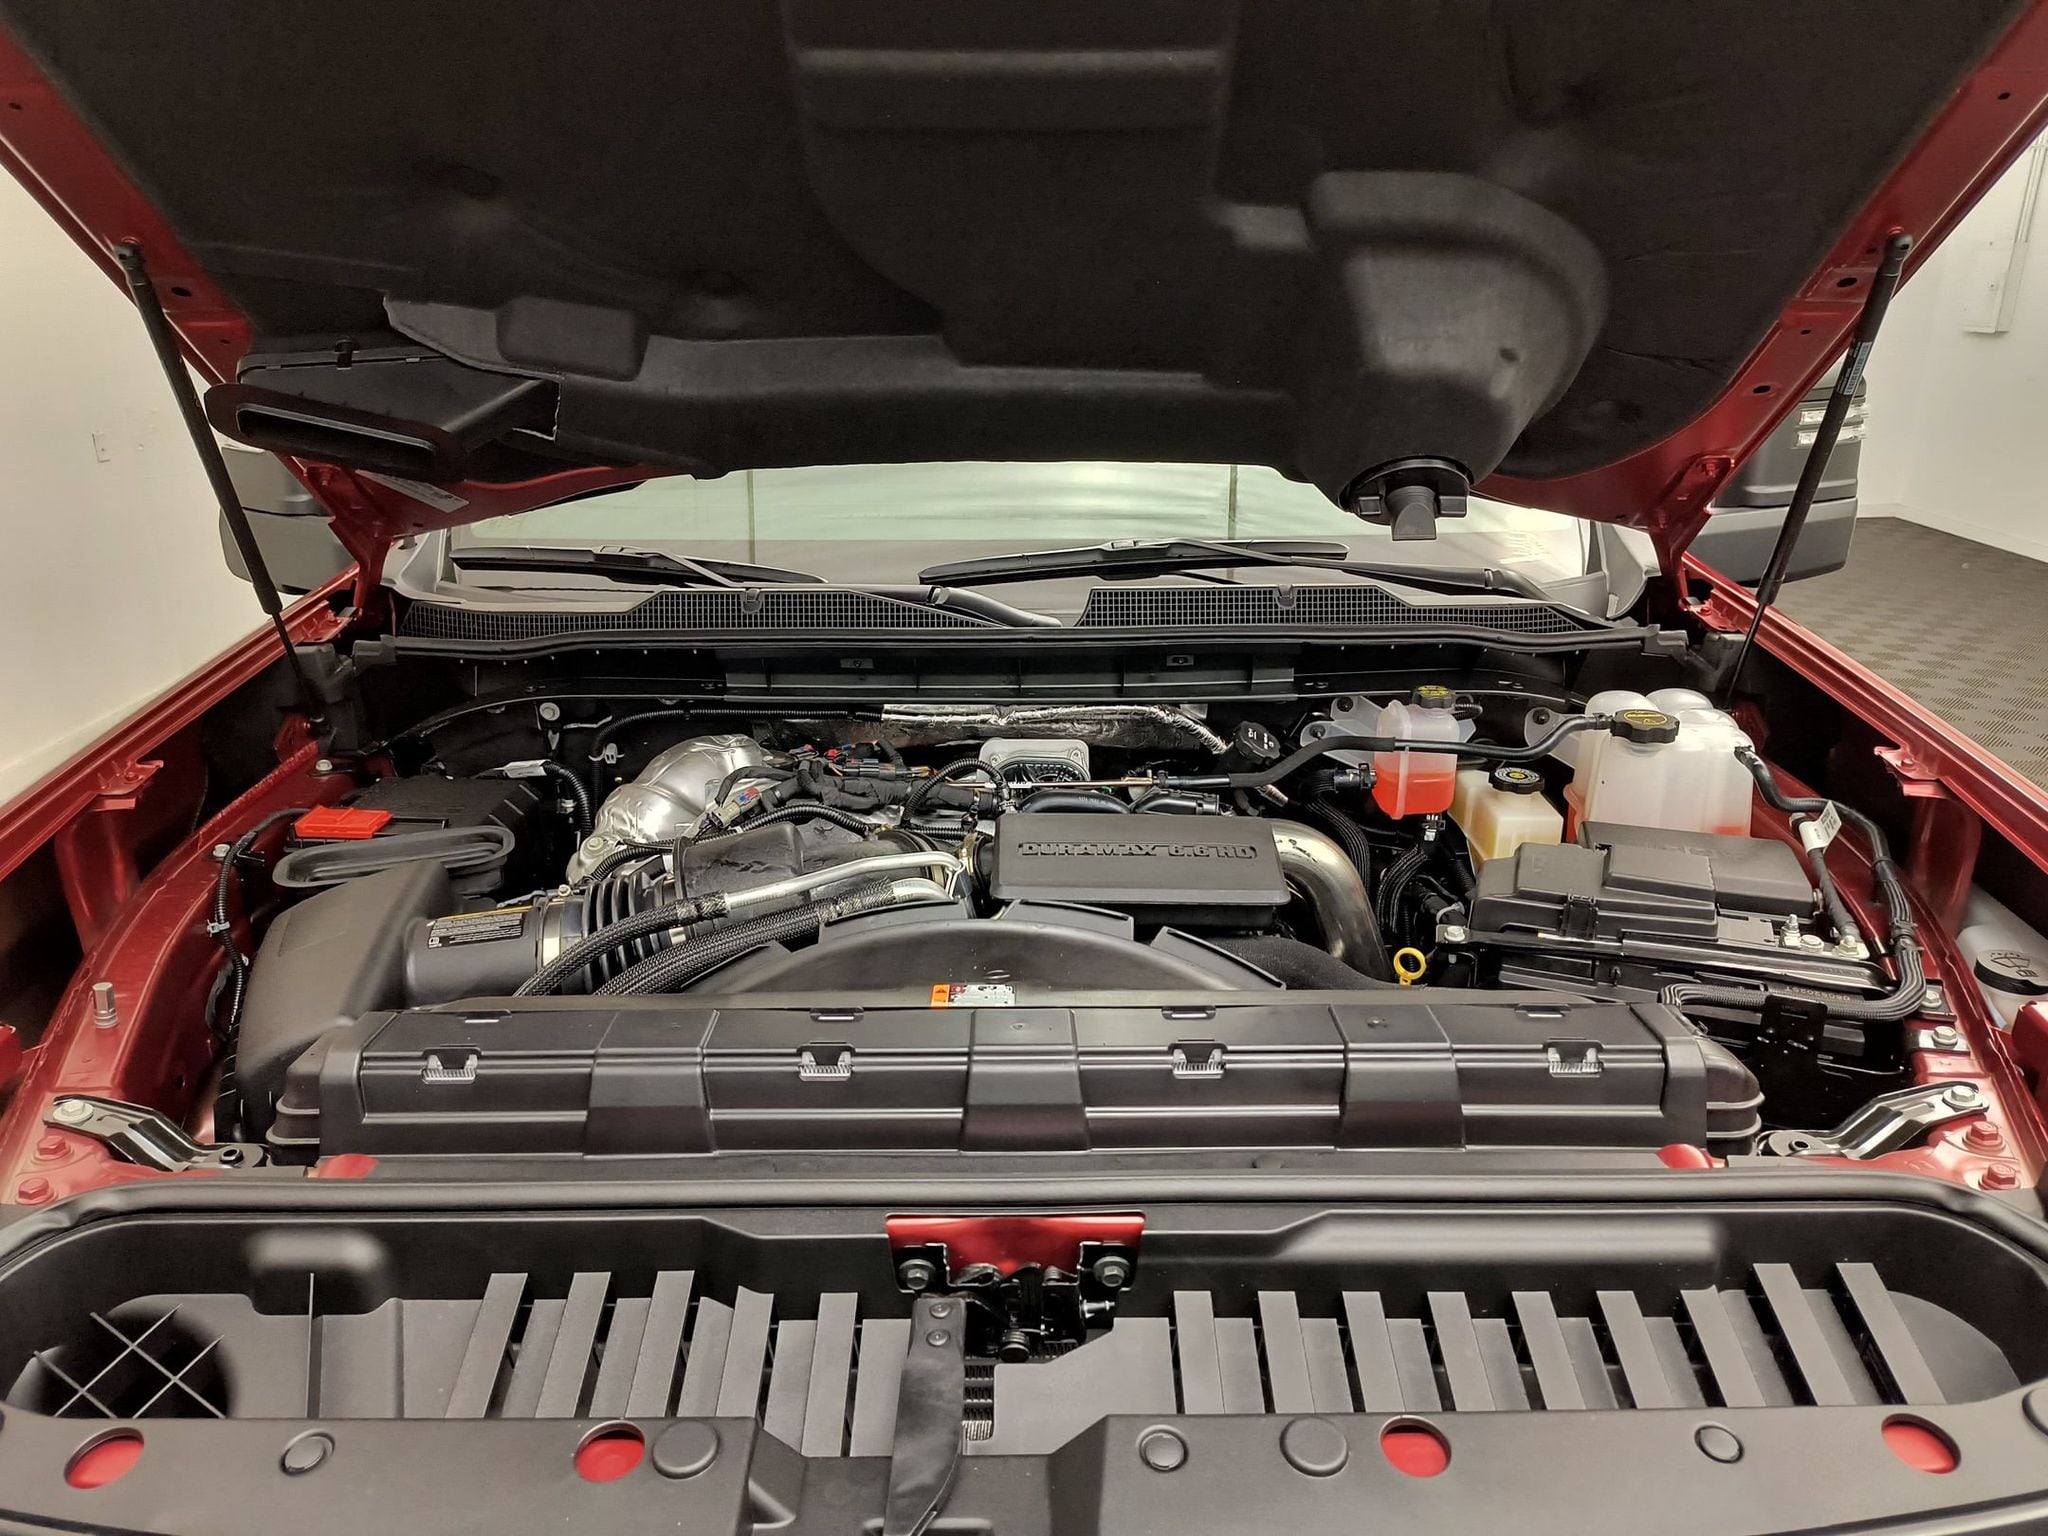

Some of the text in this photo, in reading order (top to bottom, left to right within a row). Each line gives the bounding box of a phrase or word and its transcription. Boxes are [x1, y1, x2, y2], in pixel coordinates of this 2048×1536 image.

[1019, 842, 1255, 859] DURAMAX 6.6 HD
